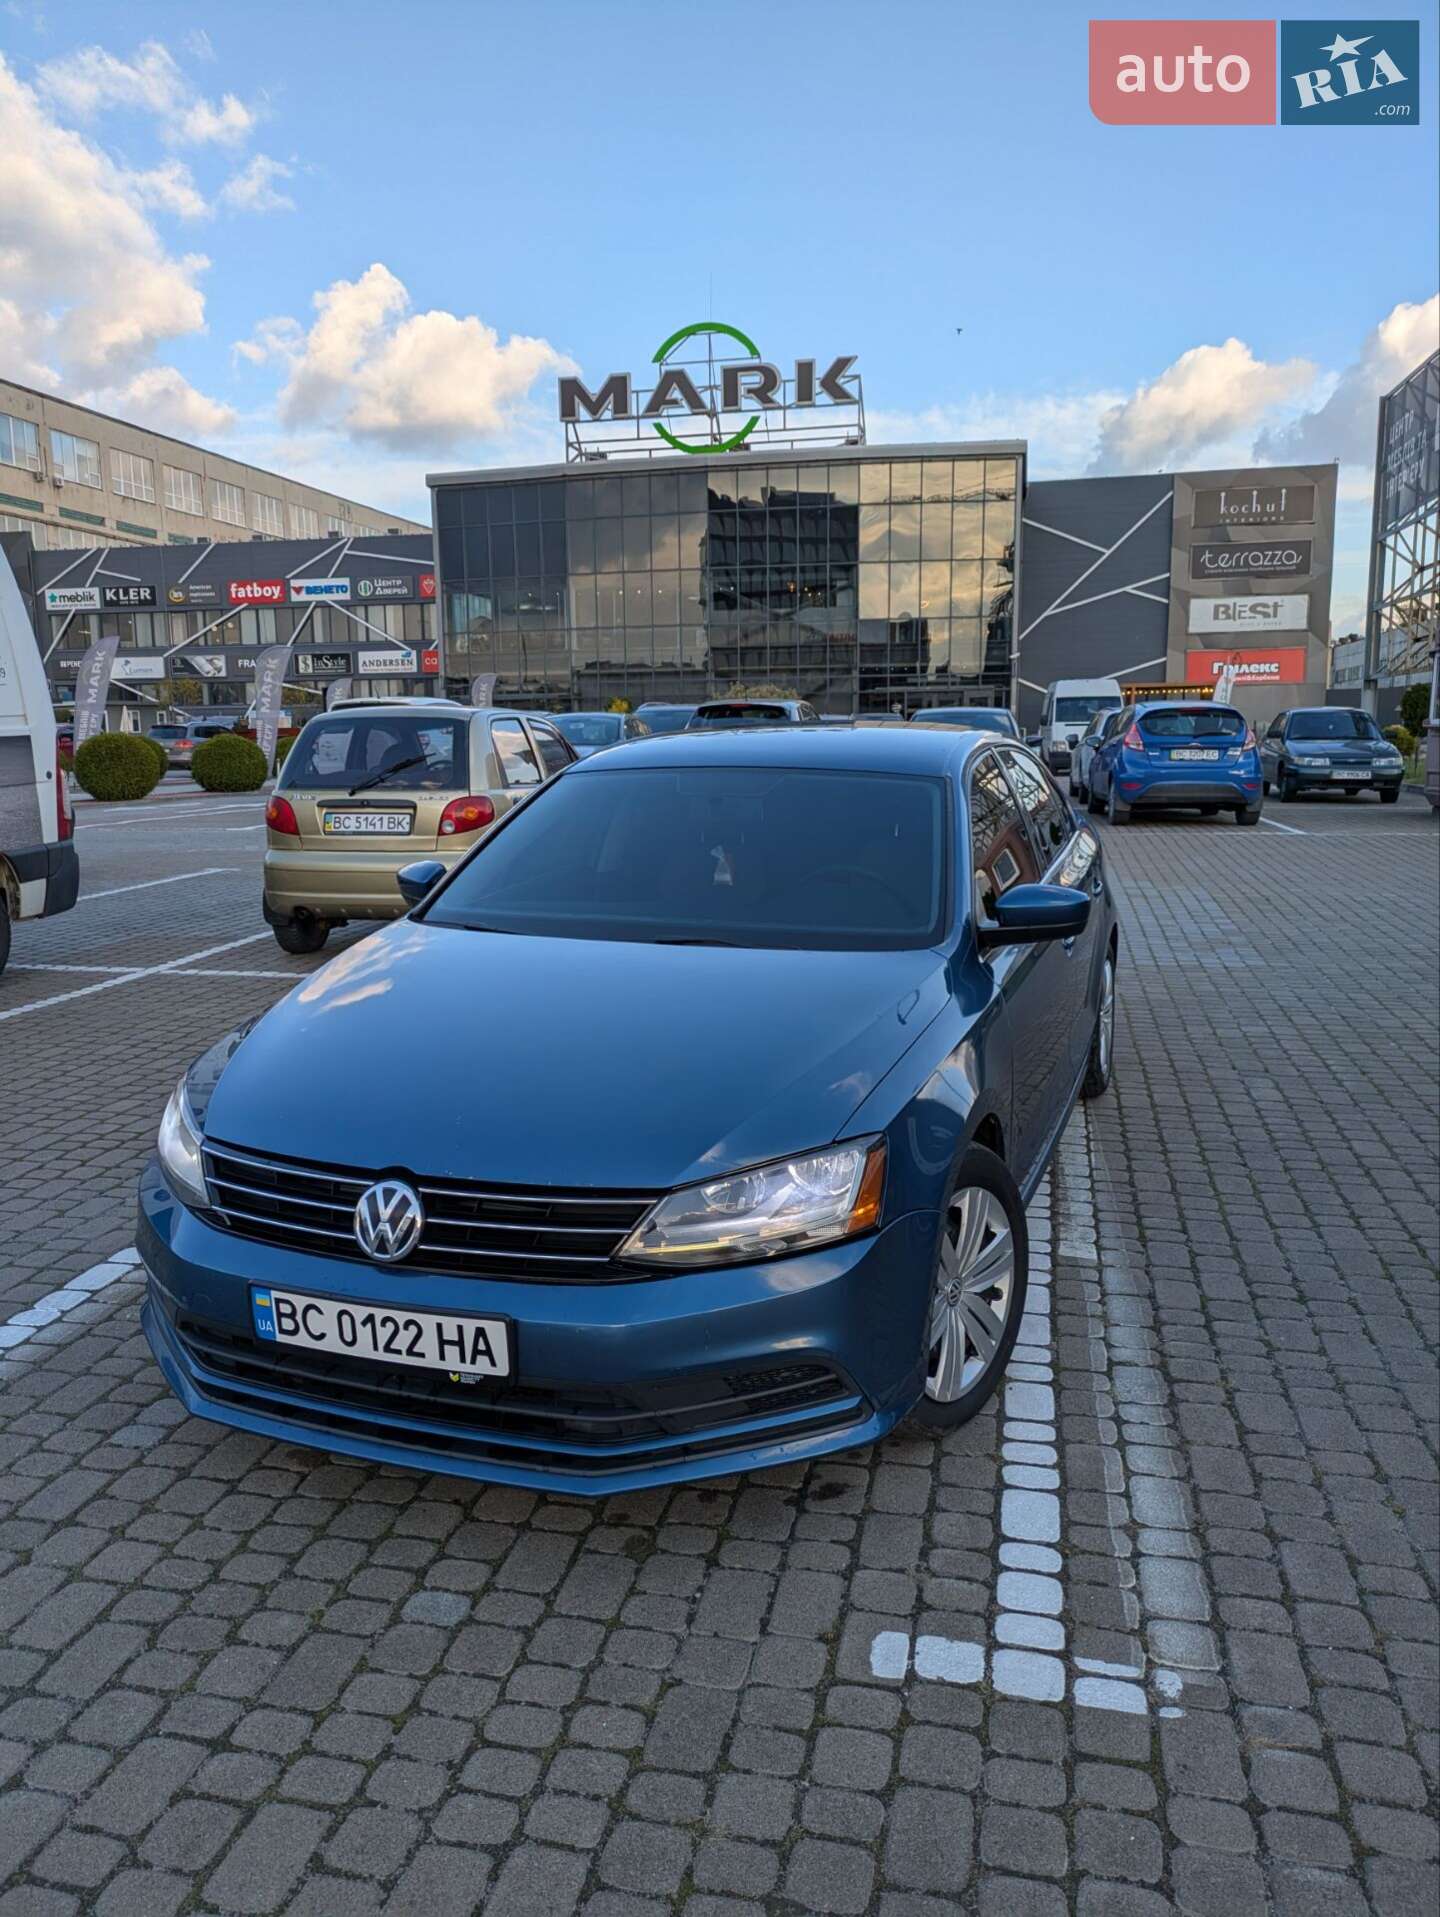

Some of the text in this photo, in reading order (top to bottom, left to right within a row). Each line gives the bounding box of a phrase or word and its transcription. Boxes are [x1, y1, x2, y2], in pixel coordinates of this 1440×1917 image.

[558, 355, 858, 422] MARK
[58, 592, 96, 603] meblik
[105, 588, 152, 601] KLER
[230, 582, 281, 599] fatboy
[238, 660, 256, 668] FRA
[87, 650, 106, 703] MARK
[260, 658, 277, 713] MARK
[333, 815, 407, 830] BC 5141 BK
[257, 1298, 497, 1368] UA BC 0122 HA
